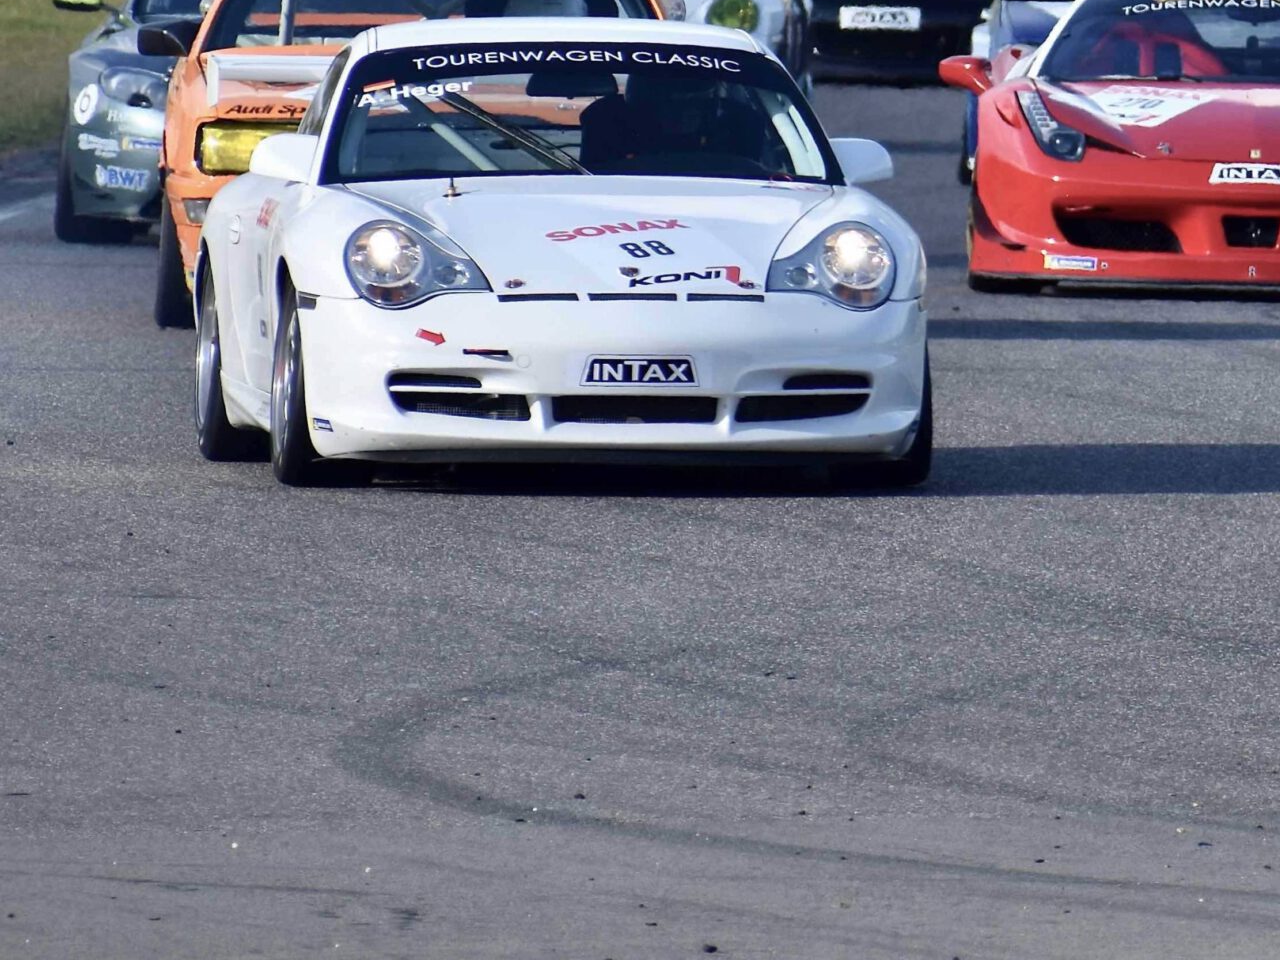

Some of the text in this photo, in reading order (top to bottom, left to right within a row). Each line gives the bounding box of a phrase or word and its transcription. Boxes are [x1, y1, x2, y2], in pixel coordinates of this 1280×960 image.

[412, 49, 742, 73] TOURENWAGEN CLASSIC
[357, 81, 473, 108] A. Heger
[225, 104, 275, 115] Audi
[107, 167, 149, 190] BWT
[545, 219, 692, 242] SONAX
[619, 240, 676, 259] 88
[628, 270, 721, 288] KONI
[593, 360, 690, 382] INTAX
